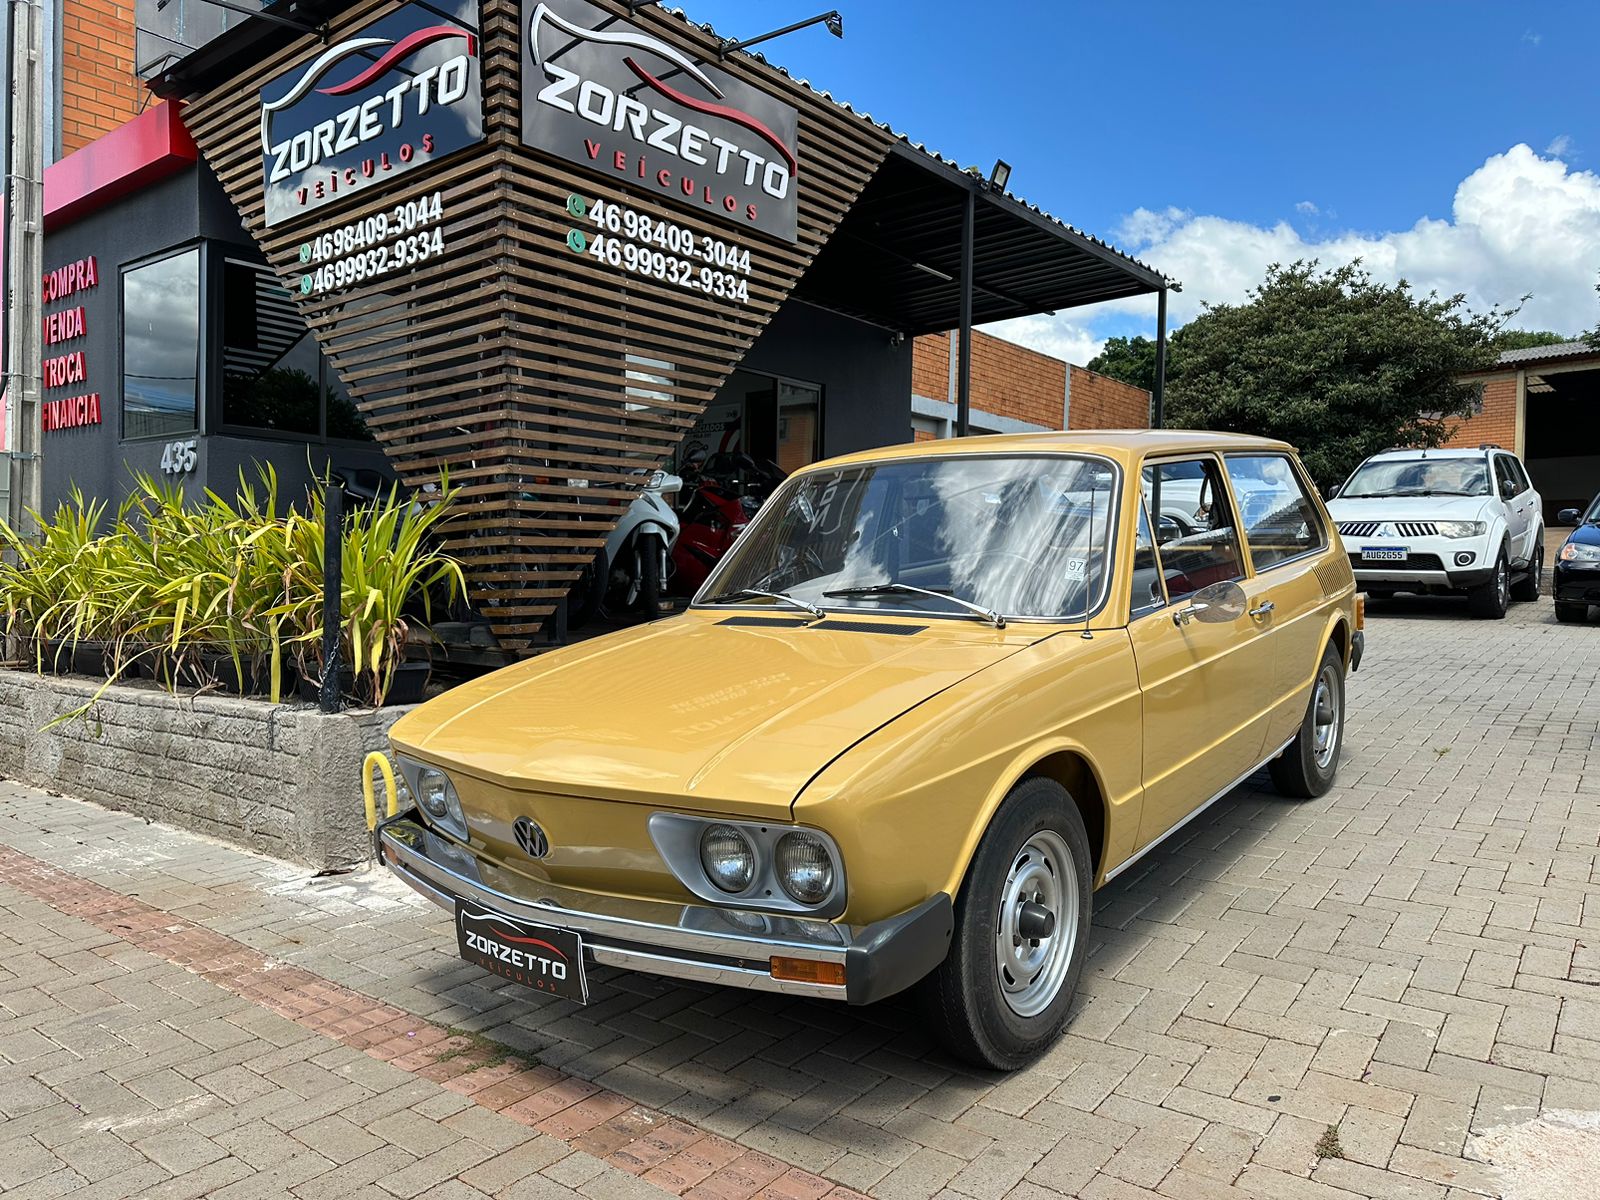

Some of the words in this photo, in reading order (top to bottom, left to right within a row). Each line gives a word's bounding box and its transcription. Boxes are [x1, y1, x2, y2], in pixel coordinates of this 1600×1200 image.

[270, 55, 468, 183] ZORZETTO
[537, 61, 790, 199] ZORZETTO
[584, 138, 758, 221] VEÍCULOS
[160, 439, 198, 474] 435
[1069, 560, 1084, 571] 97
[465, 929, 566, 980] ZORZETTO
